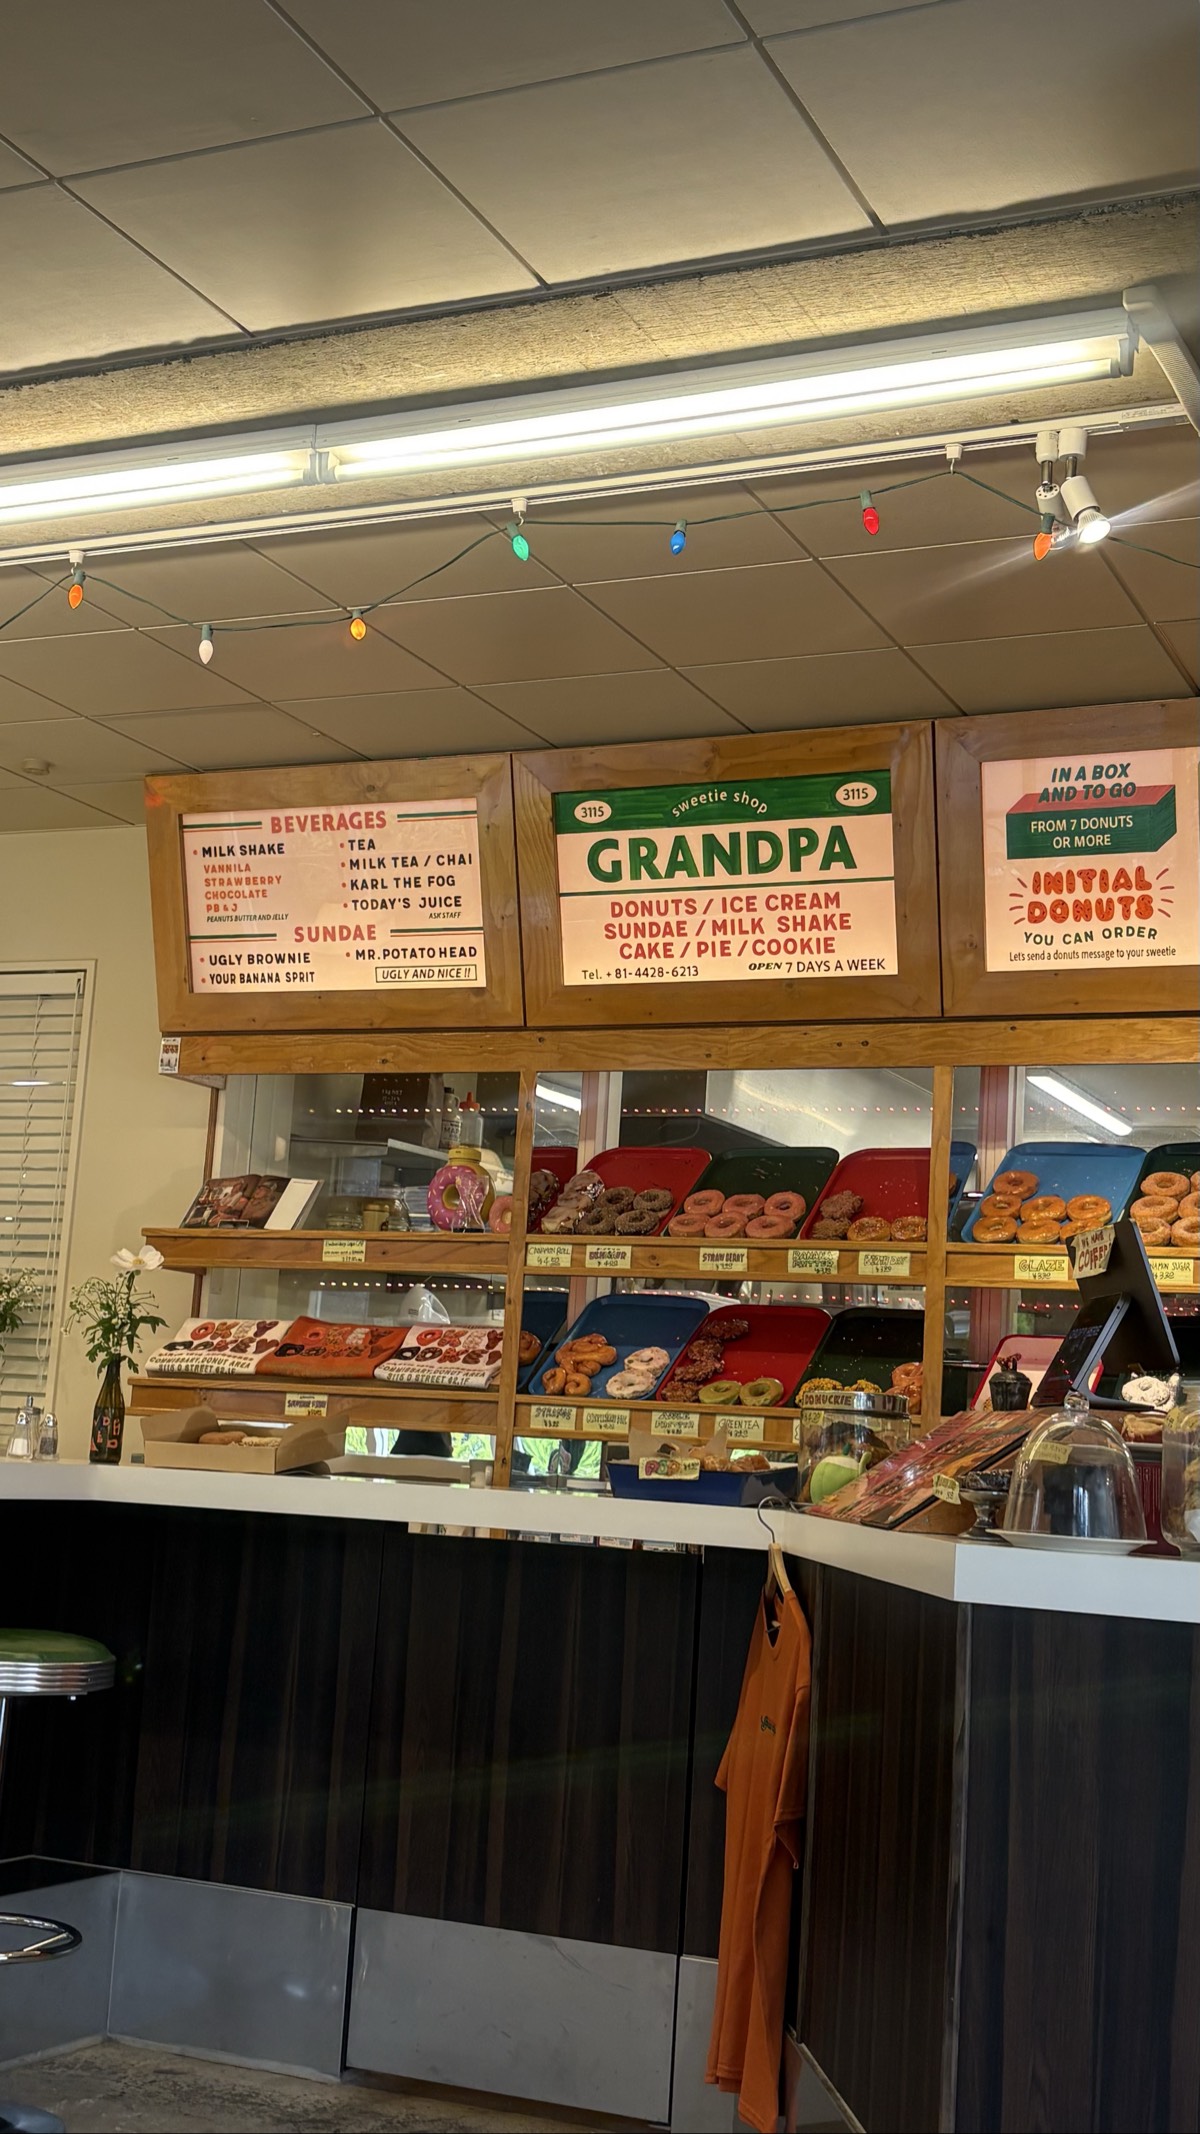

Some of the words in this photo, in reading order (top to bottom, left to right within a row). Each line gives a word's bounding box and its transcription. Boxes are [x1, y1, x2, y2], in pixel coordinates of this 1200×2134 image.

[1051, 767, 1071, 783] IN
[1075, 766, 1086, 781] A
[1092, 763, 1131, 781] BOX
[842, 788, 869, 800] 3115
[1039, 787, 1077, 803] AND
[1083, 785, 1105, 800] TO
[1109, 782, 1136, 798] GO
[672, 789, 728, 818] sweetie
[733, 791, 768, 815] shop
[580, 806, 604, 818] 3115
[270, 811, 387, 834] BEVERAGES
[1031, 820, 1067, 833] FROM
[1070, 819, 1076, 830] 7
[1080, 815, 1133, 830] DONUTS
[348, 839, 376, 851] TEA
[1053, 837, 1070, 849] OR
[1074, 835, 1111, 847] MORE
[202, 845, 235, 858] MILK
[239, 843, 285, 856] SHAKE
[587, 825, 857, 883] GRANDPA
[204, 863, 251, 873] VANNILA
[350, 857, 386, 870] MILK
[391, 856, 419, 868] TEA
[424, 855, 431, 867] /
[436, 853, 473, 866] CHAI
[204, 875, 282, 887] STRAWBERRY
[351, 879, 387, 890] KARL
[393, 877, 422, 888] THE
[427, 876, 456, 888] FOG
[1032, 866, 1152, 895] INITIAL
[205, 889, 268, 900] CHOCOLATE
[206, 904, 220, 913] PB
[231, 904, 237, 912] J
[352, 898, 411, 911] TODAY'S
[419, 896, 462, 909] JUICE
[611, 898, 698, 918] DONUTS
[702, 899, 714, 914] /
[722, 897, 757, 914] ICE
[765, 892, 841, 911] CREAM
[1027, 894, 1153, 924] DONUTS
[207, 915, 234, 923] PEANUTS
[234, 914, 257, 922] BUTTER
[271, 913, 289, 921] JELLY
[294, 924, 377, 943] SUNDAE
[604, 920, 688, 940] SUNDAE
[695, 920, 707, 936] /
[712, 918, 764, 936] MILK
[777, 914, 851, 933] SHAKE
[1024, 931, 1054, 946] YOU
[1063, 931, 1094, 944] CAN
[1102, 926, 1157, 940] ORDER
[439, 946, 478, 958] HEAD
[619, 942, 674, 960] CAKE
[680, 942, 691, 958] /
[697, 940, 731, 958] PIE
[737, 940, 748, 955] /
[752, 937, 836, 957] COOKIE
[1027, 951, 1045, 961] send
[1053, 950, 1079, 960] donuts
[1082, 949, 1115, 961] message
[1117, 949, 1124, 958] to
[1126, 949, 1144, 959] your
[1146, 946, 1176, 957] sweetie
[209, 954, 242, 966] UGLY
[247, 953, 311, 965] BROWNIE
[748, 962, 782, 971] OPEN
[785, 962, 793, 973] 7
[797, 960, 831, 973] DAYS
[834, 960, 844, 972] A
[847, 958, 885, 971] WEEK
[209, 973, 236, 985] YOUR
[240, 972, 280, 984] BANANA
[285, 972, 315, 983] SPRIT
[382, 970, 410, 981] UGLY
[412, 969, 435, 979] AND
[437, 968, 461, 979] NICE
[582, 968, 602, 980] Tel.
[1019, 1259, 1065, 1272] GLAZE
[1172, 1262, 1191, 1271] SUGAR
[185, 1365, 213, 1373] STREET
[415, 1375, 445, 1383] STREET
[744, 1420, 759, 1429] TEA
